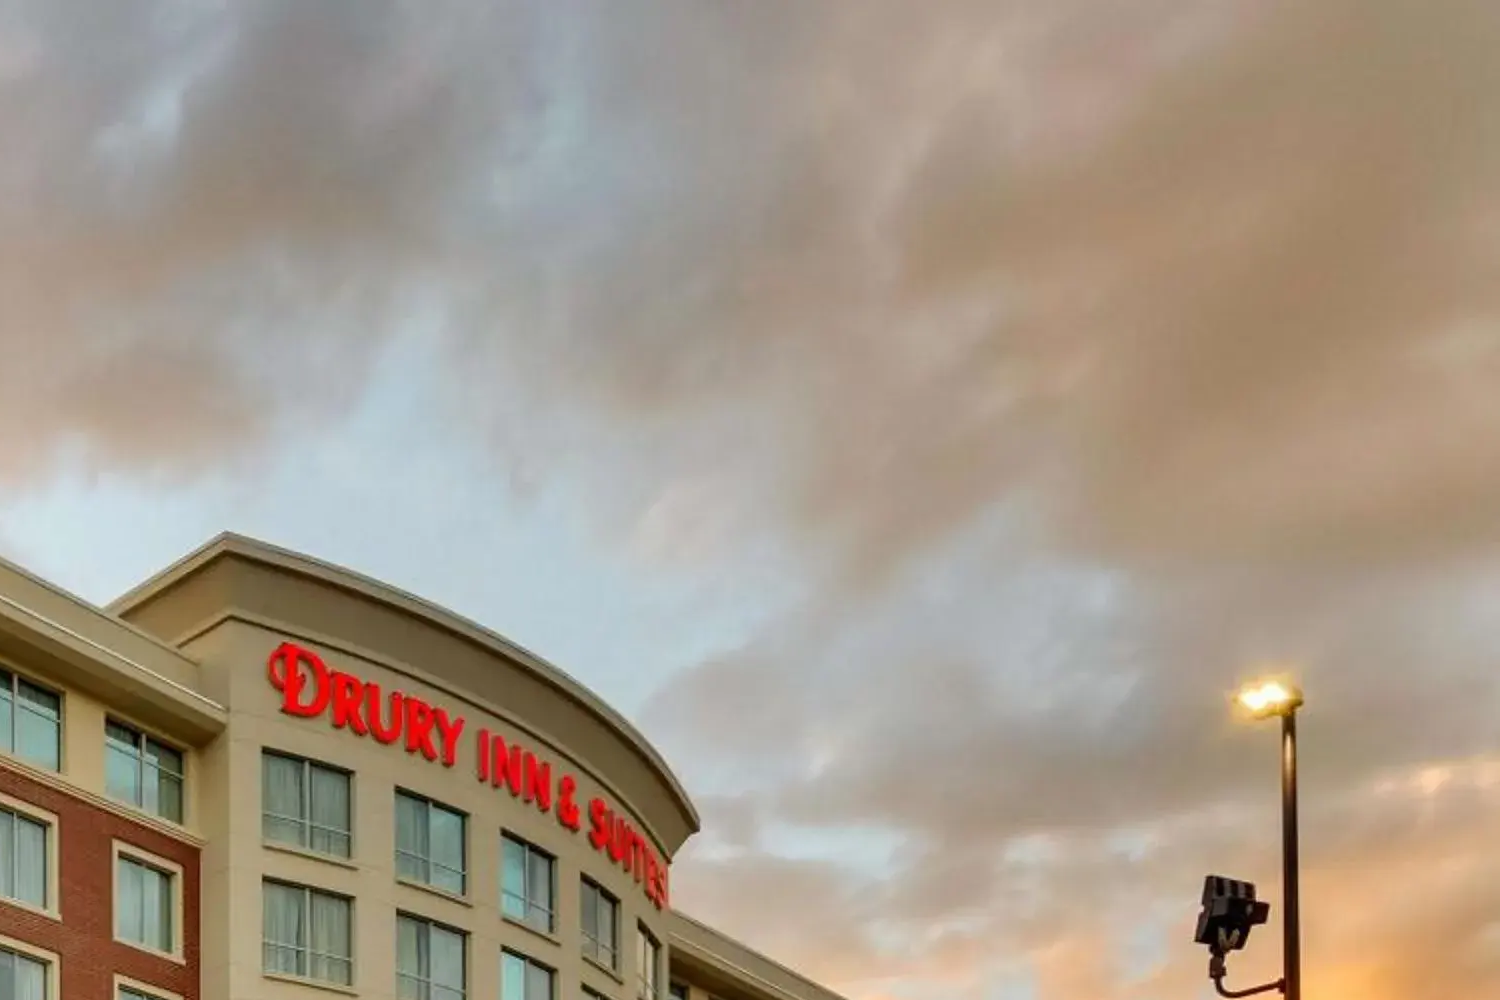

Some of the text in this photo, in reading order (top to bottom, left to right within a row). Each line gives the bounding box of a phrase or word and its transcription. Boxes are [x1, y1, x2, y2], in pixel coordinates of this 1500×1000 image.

[268, 642, 466, 768] DRURY
[477, 728, 551, 814] INN
[557, 774, 581, 832] &
